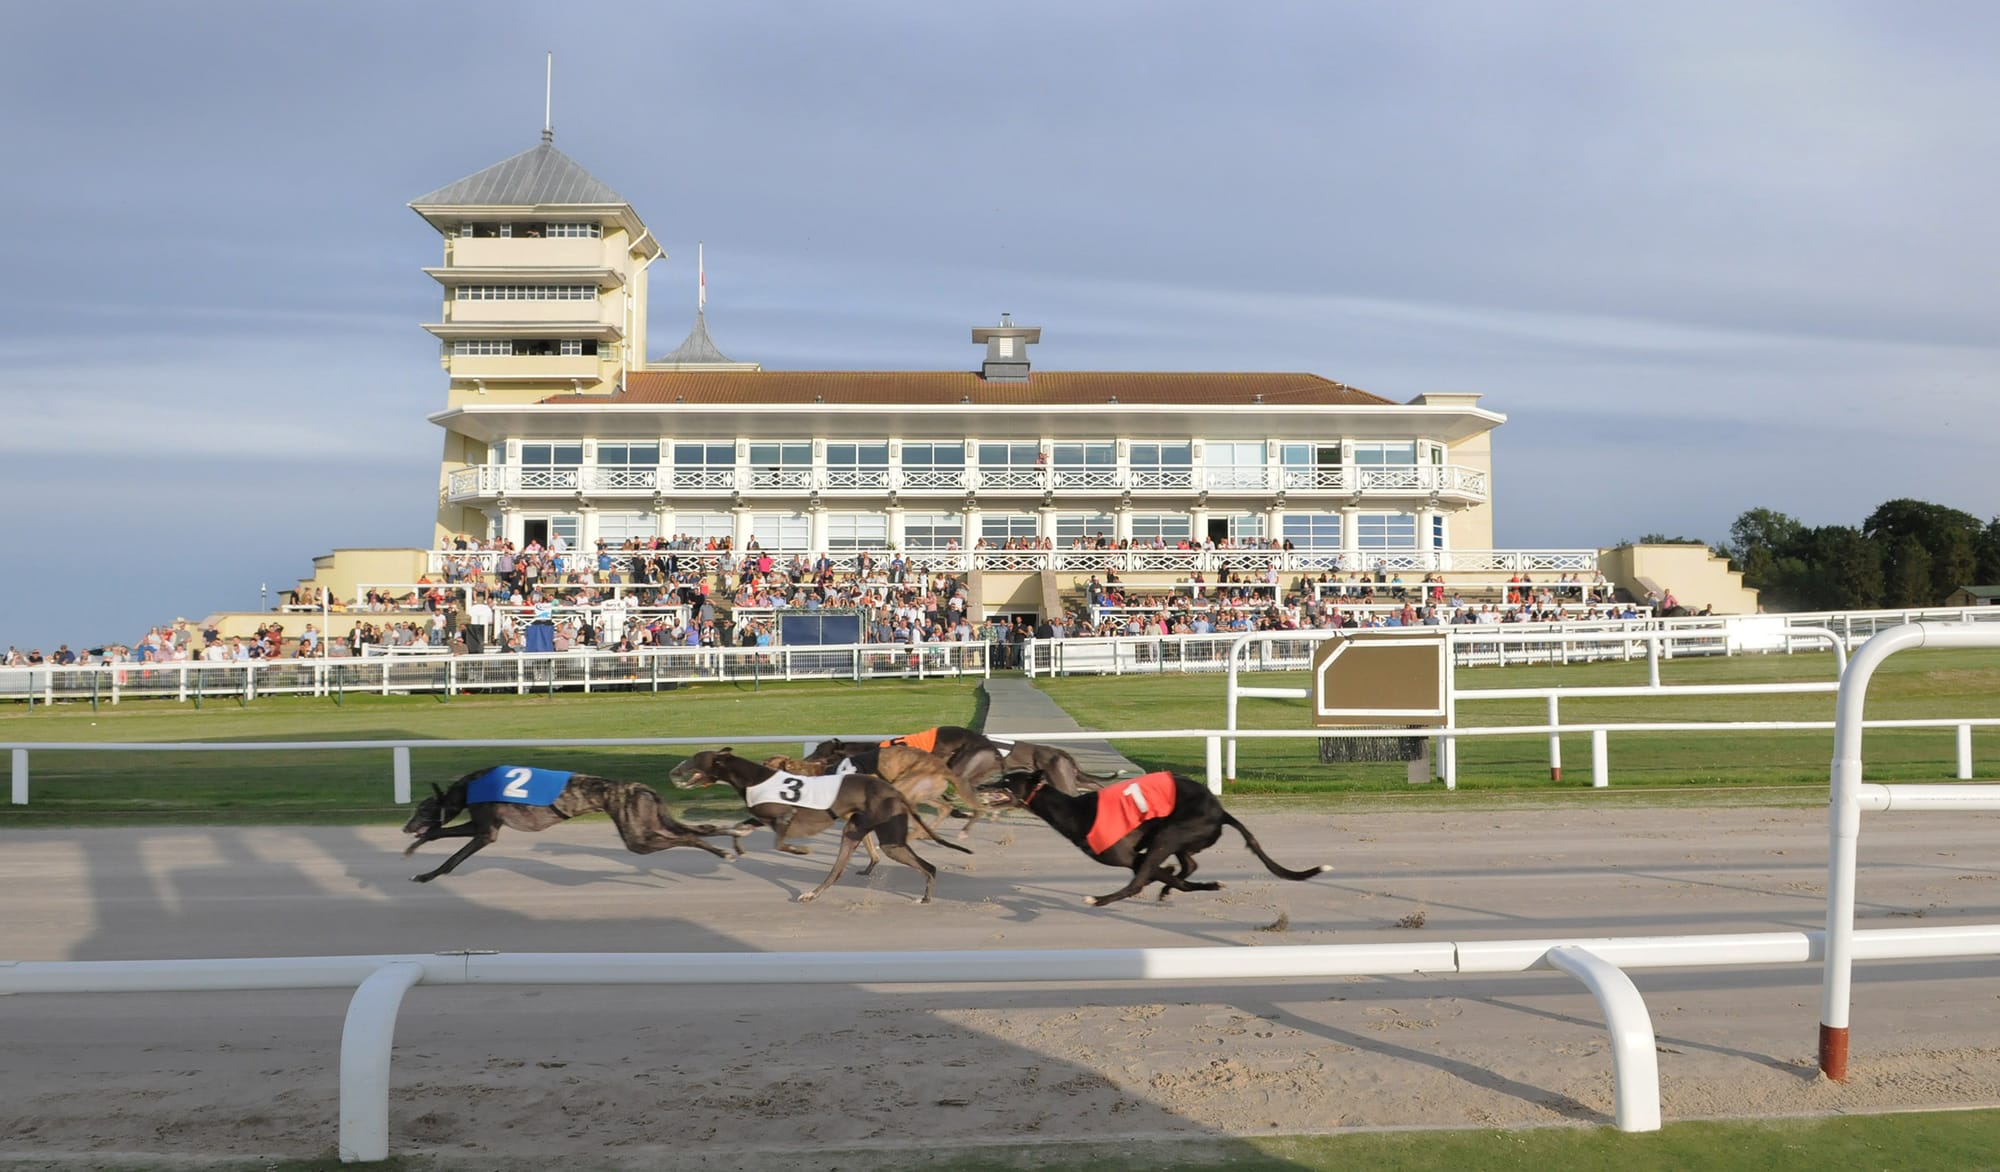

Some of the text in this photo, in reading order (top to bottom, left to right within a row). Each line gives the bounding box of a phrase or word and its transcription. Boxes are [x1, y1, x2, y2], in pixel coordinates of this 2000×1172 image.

[836, 757, 857, 776] 4
[503, 768, 532, 798] 2
[780, 777, 804, 802] 3
[1122, 783, 1149, 813] 1
